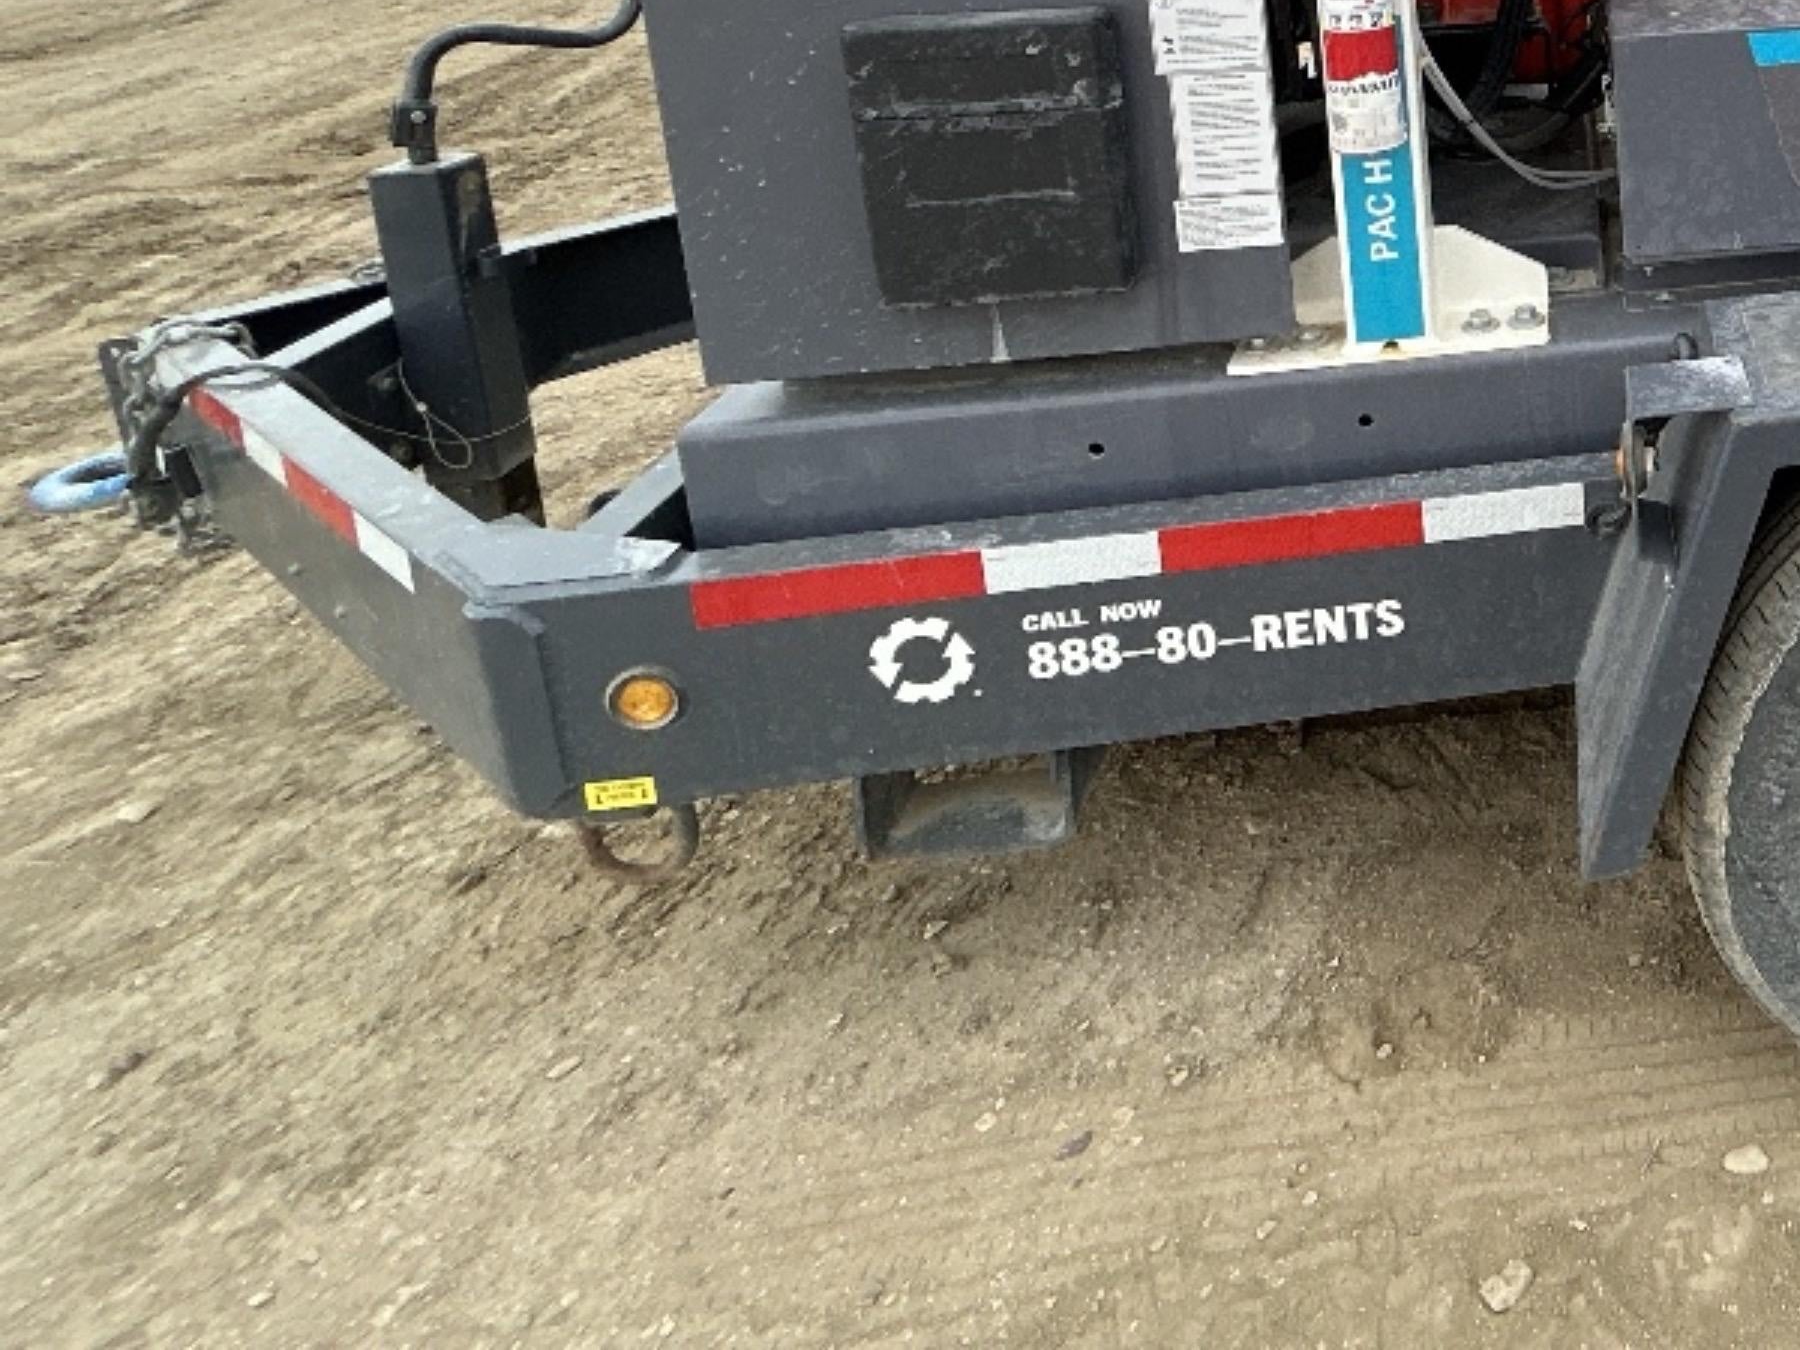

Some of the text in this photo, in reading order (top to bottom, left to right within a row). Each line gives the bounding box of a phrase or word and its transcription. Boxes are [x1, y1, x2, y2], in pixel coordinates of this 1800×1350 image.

[1365, 193, 1400, 262] PAC
[1022, 599, 1163, 632] CALL NOW
